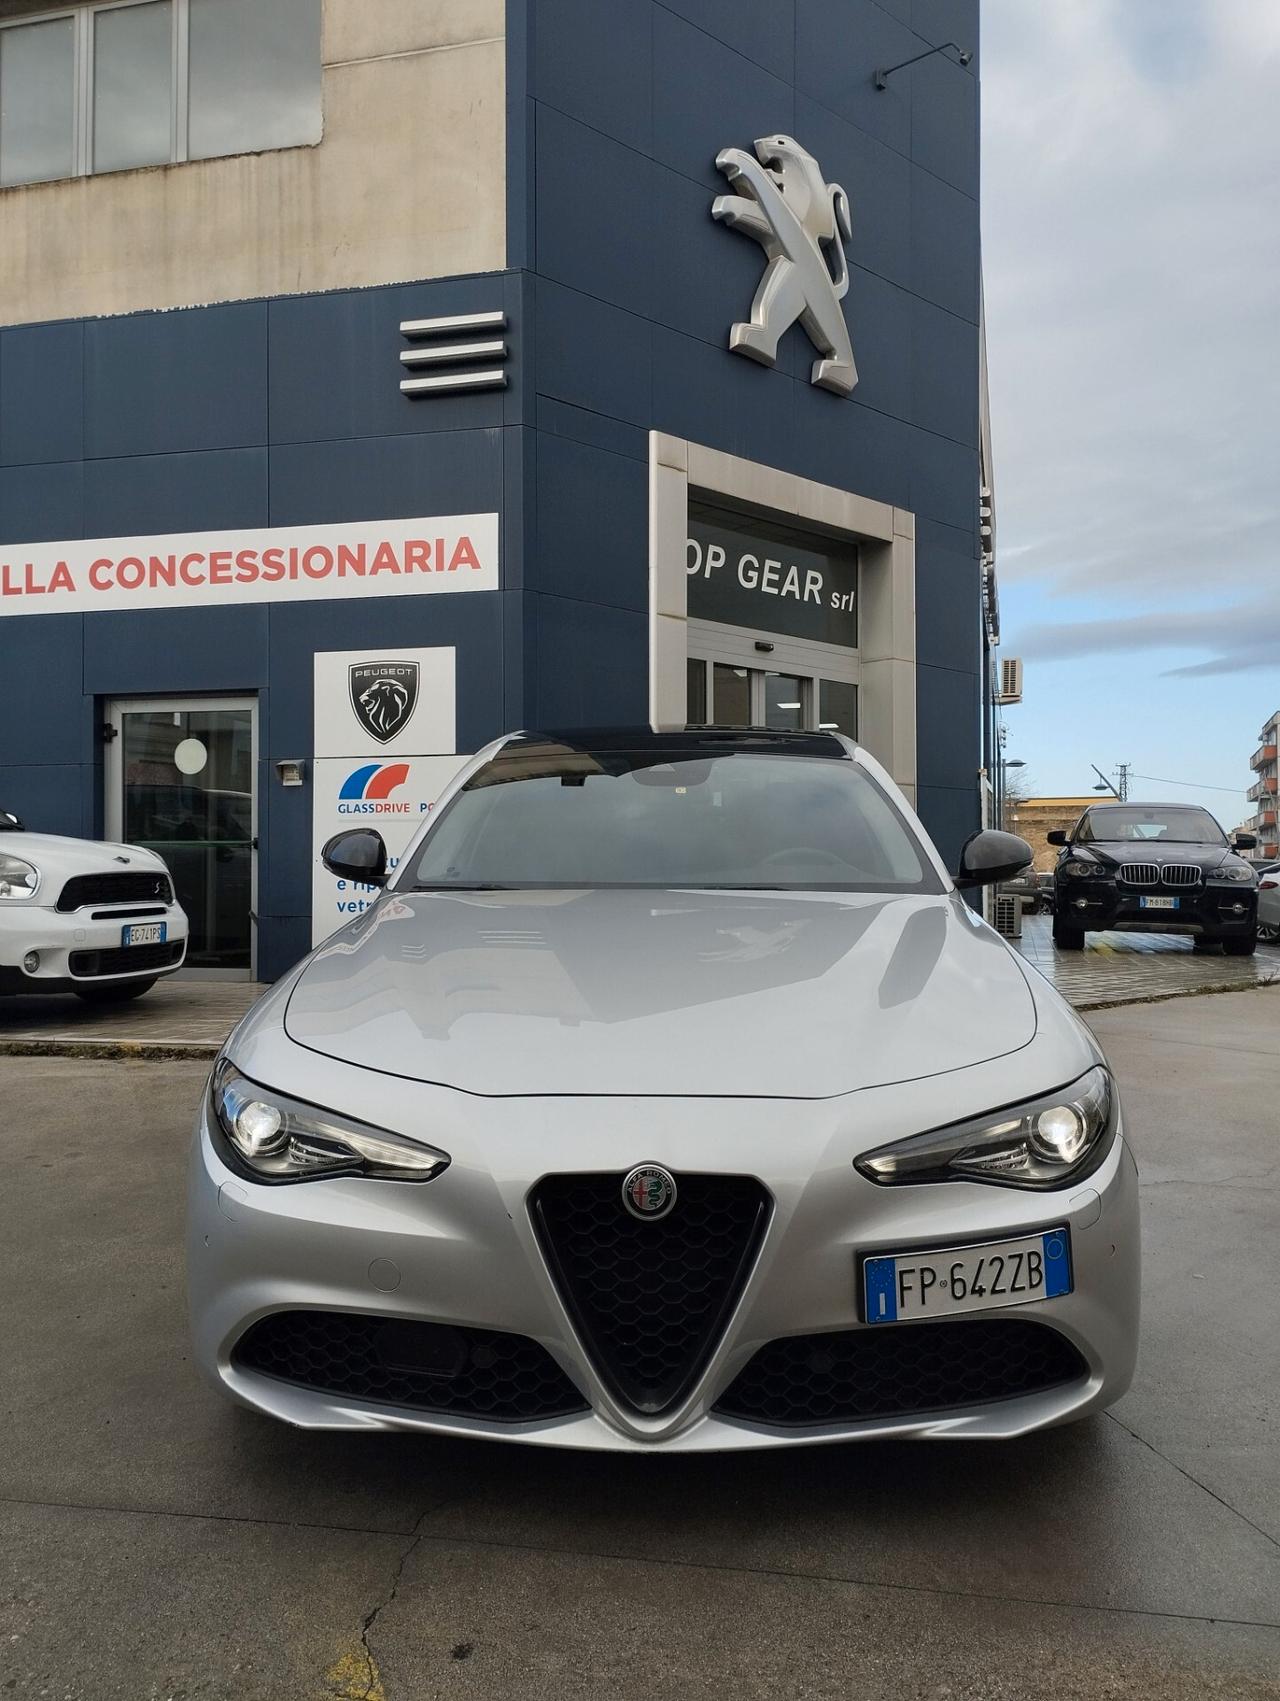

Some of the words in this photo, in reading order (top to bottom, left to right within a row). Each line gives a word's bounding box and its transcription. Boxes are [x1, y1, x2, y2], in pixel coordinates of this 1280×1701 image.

[2, 561, 76, 596] LLA
[88, 536, 481, 592] CONCESSIONARIA
[686, 538, 726, 579] OP
[737, 554, 823, 604] GEAR
[830, 591, 854, 612] srl
[355, 668, 413, 678] PEUGEOT
[337, 803, 411, 814] GLASSDRIVE
